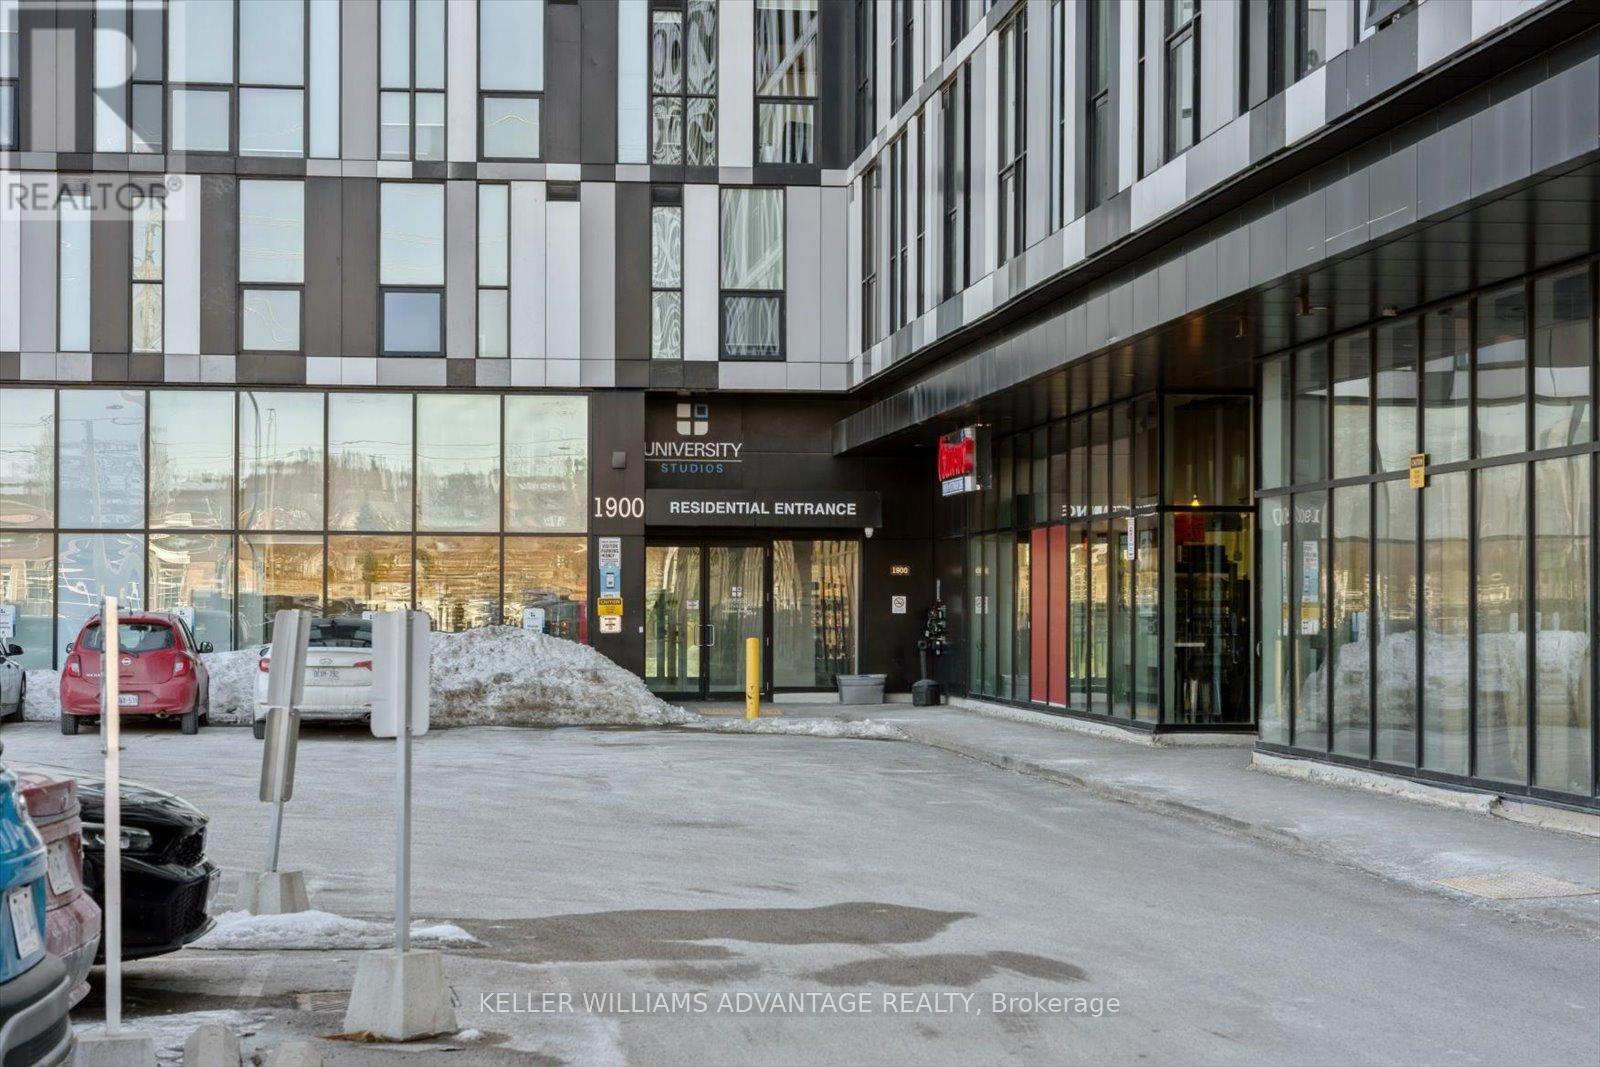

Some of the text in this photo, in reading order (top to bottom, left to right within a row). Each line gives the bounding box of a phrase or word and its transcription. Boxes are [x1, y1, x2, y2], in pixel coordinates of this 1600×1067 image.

[644, 442, 743, 458] UNIVERSITY
[661, 463, 724, 473] STUDIOS
[594, 497, 644, 518] 1900
[670, 501, 857, 516] RESIDENTIAL ENTRANCE
[892, 566, 908, 574] 1900
